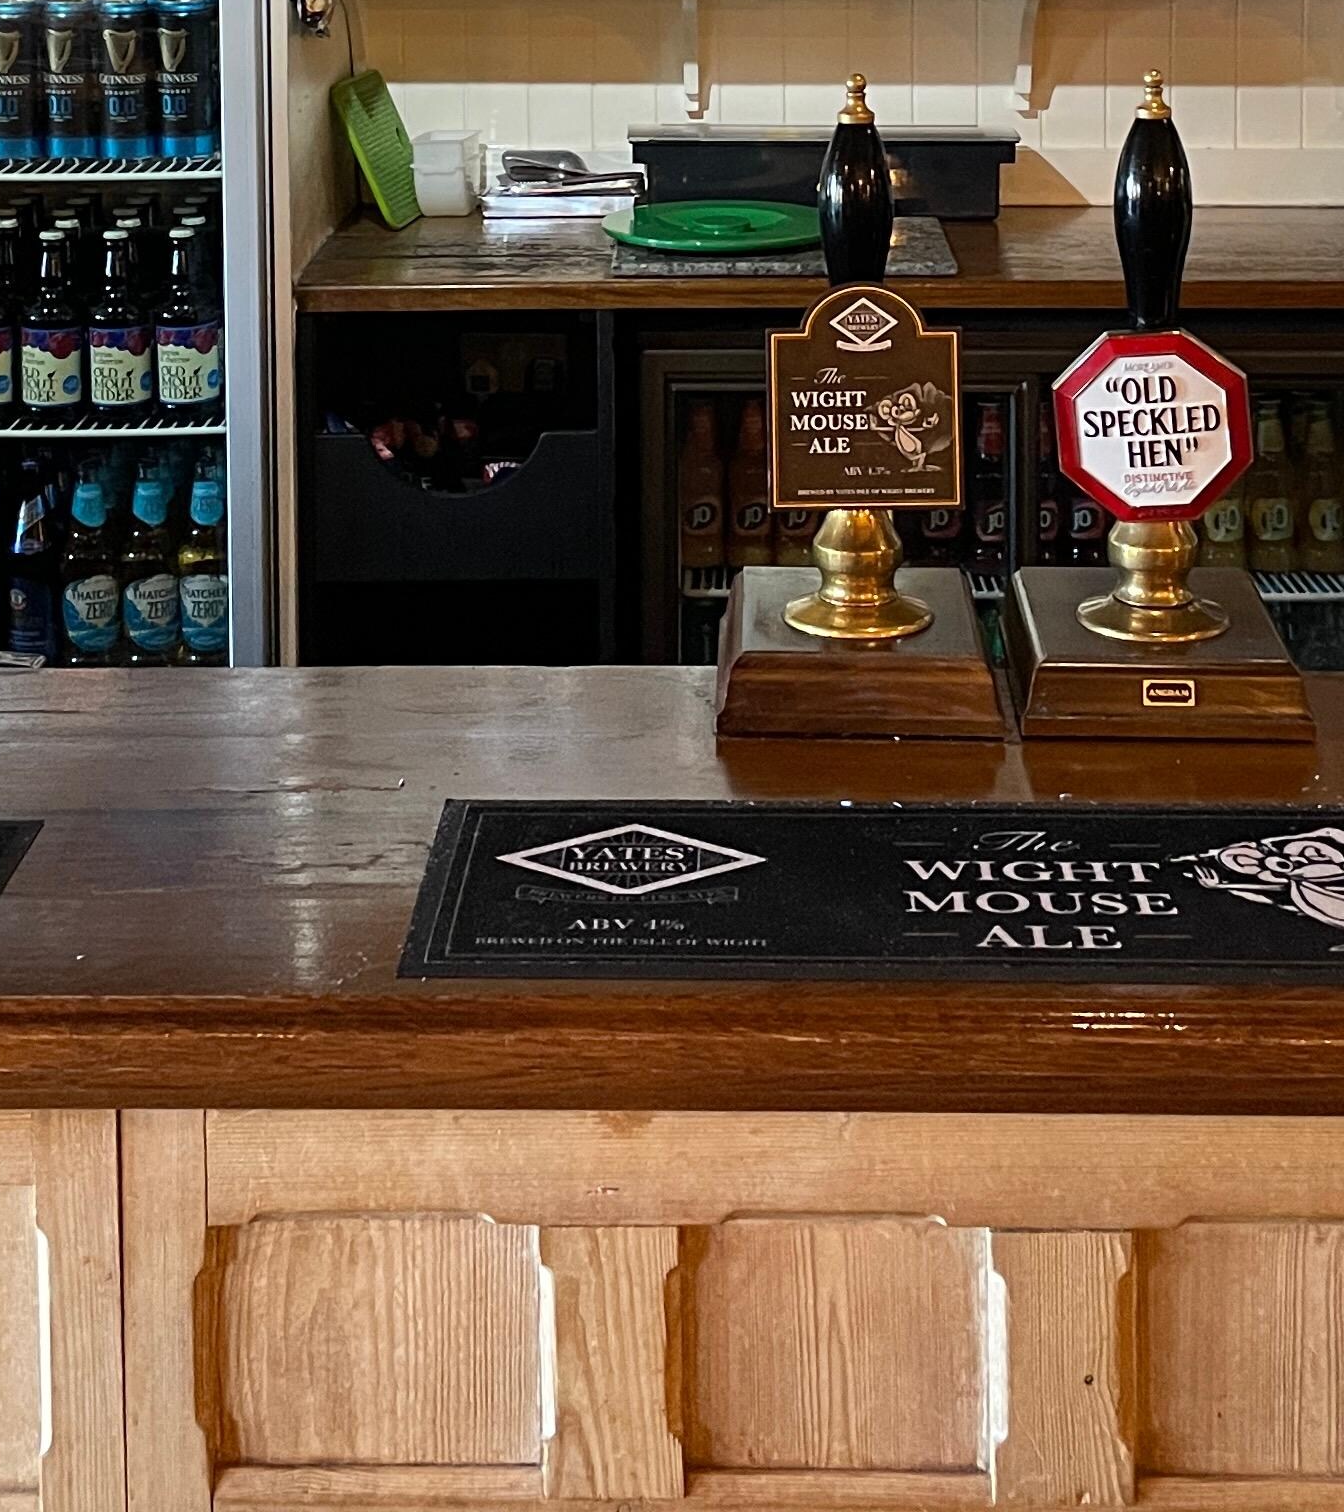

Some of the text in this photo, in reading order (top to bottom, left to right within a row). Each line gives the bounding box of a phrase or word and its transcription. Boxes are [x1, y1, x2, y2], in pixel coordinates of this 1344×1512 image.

[99, 73, 147, 85] GUINNESS
[813, 367, 847, 384] The
[791, 391, 867, 408] WIGHT
[790, 414, 869, 431] MOUSE
[1083, 404, 1221, 437] SPECKLED
[808, 437, 851, 454] ALE
[569, 861, 692, 872] BREWERY
[903, 859, 1162, 884] WIGHT
[904, 891, 1180, 916] MOUSE
[567, 919, 635, 930] ABV
[976, 925, 1122, 950] ALE
